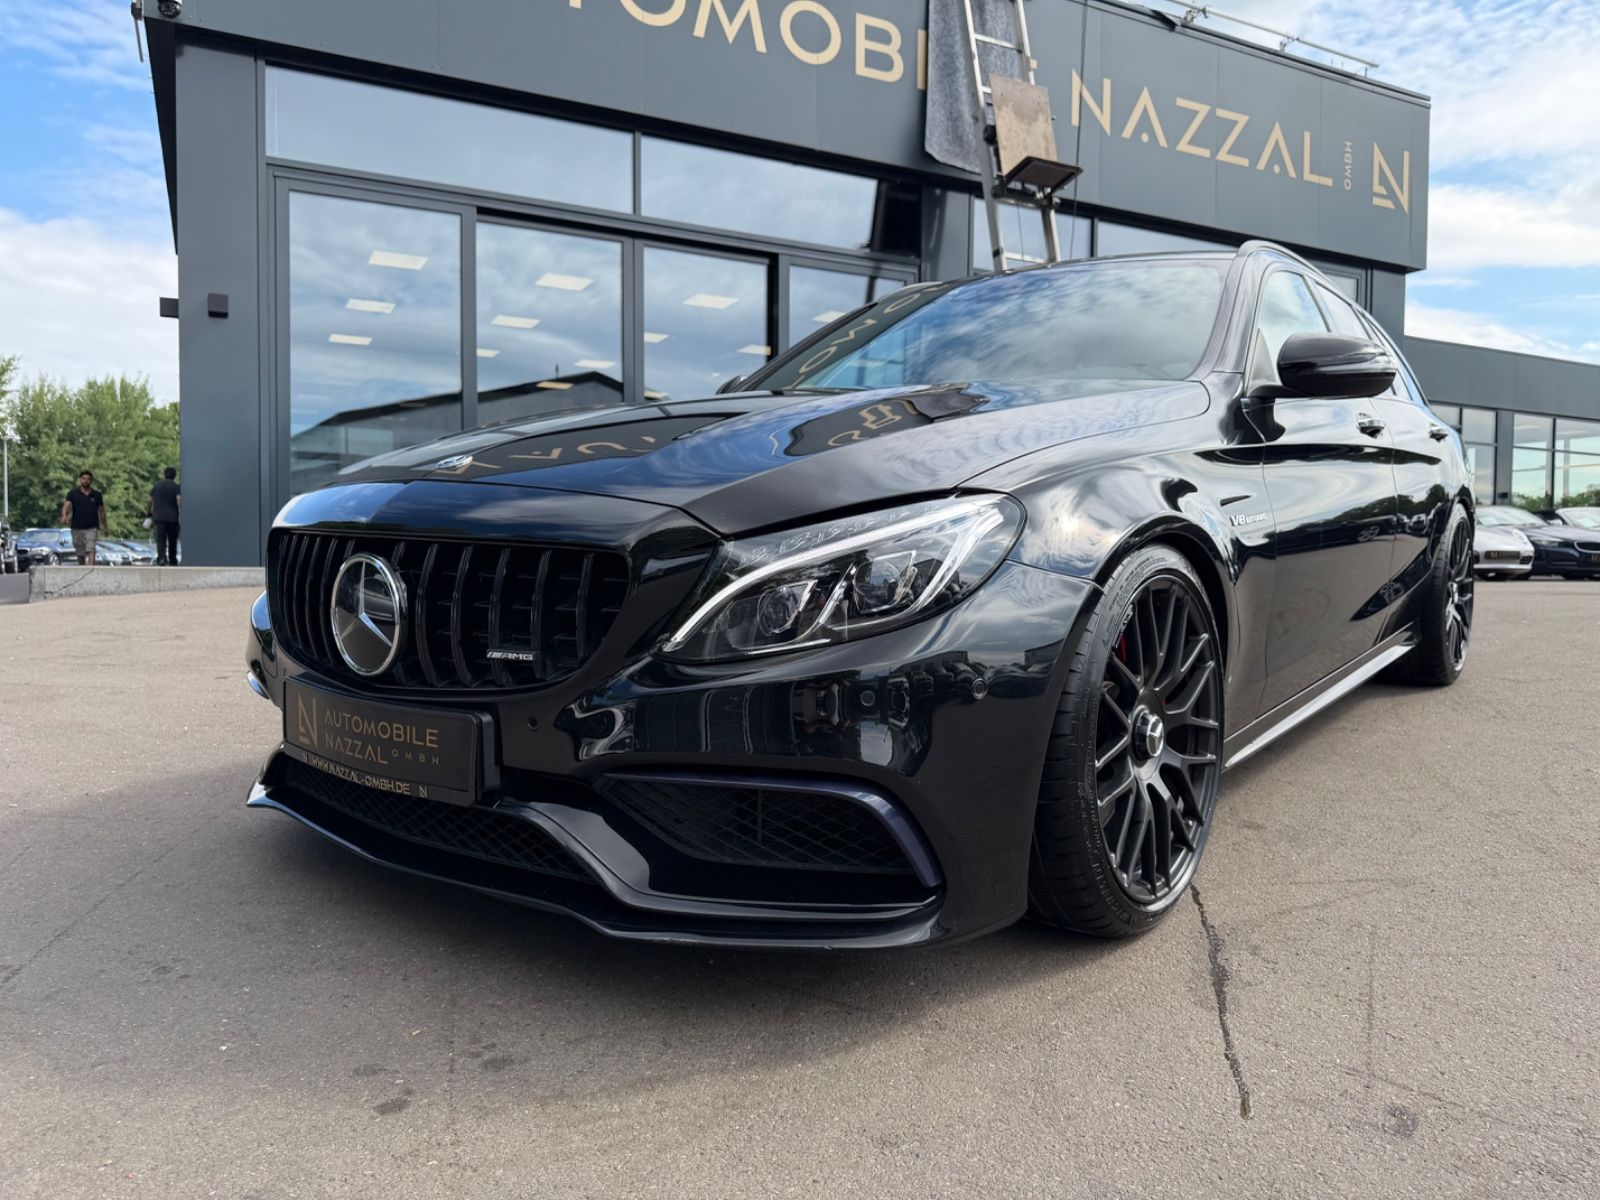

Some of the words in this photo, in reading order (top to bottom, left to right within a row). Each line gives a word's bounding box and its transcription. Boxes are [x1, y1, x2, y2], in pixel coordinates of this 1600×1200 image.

[1071, 68, 1333, 186] NAZZAL
[324, 708, 439, 749] AUTOMOBILE
[325, 733, 389, 765] NAZZAL
